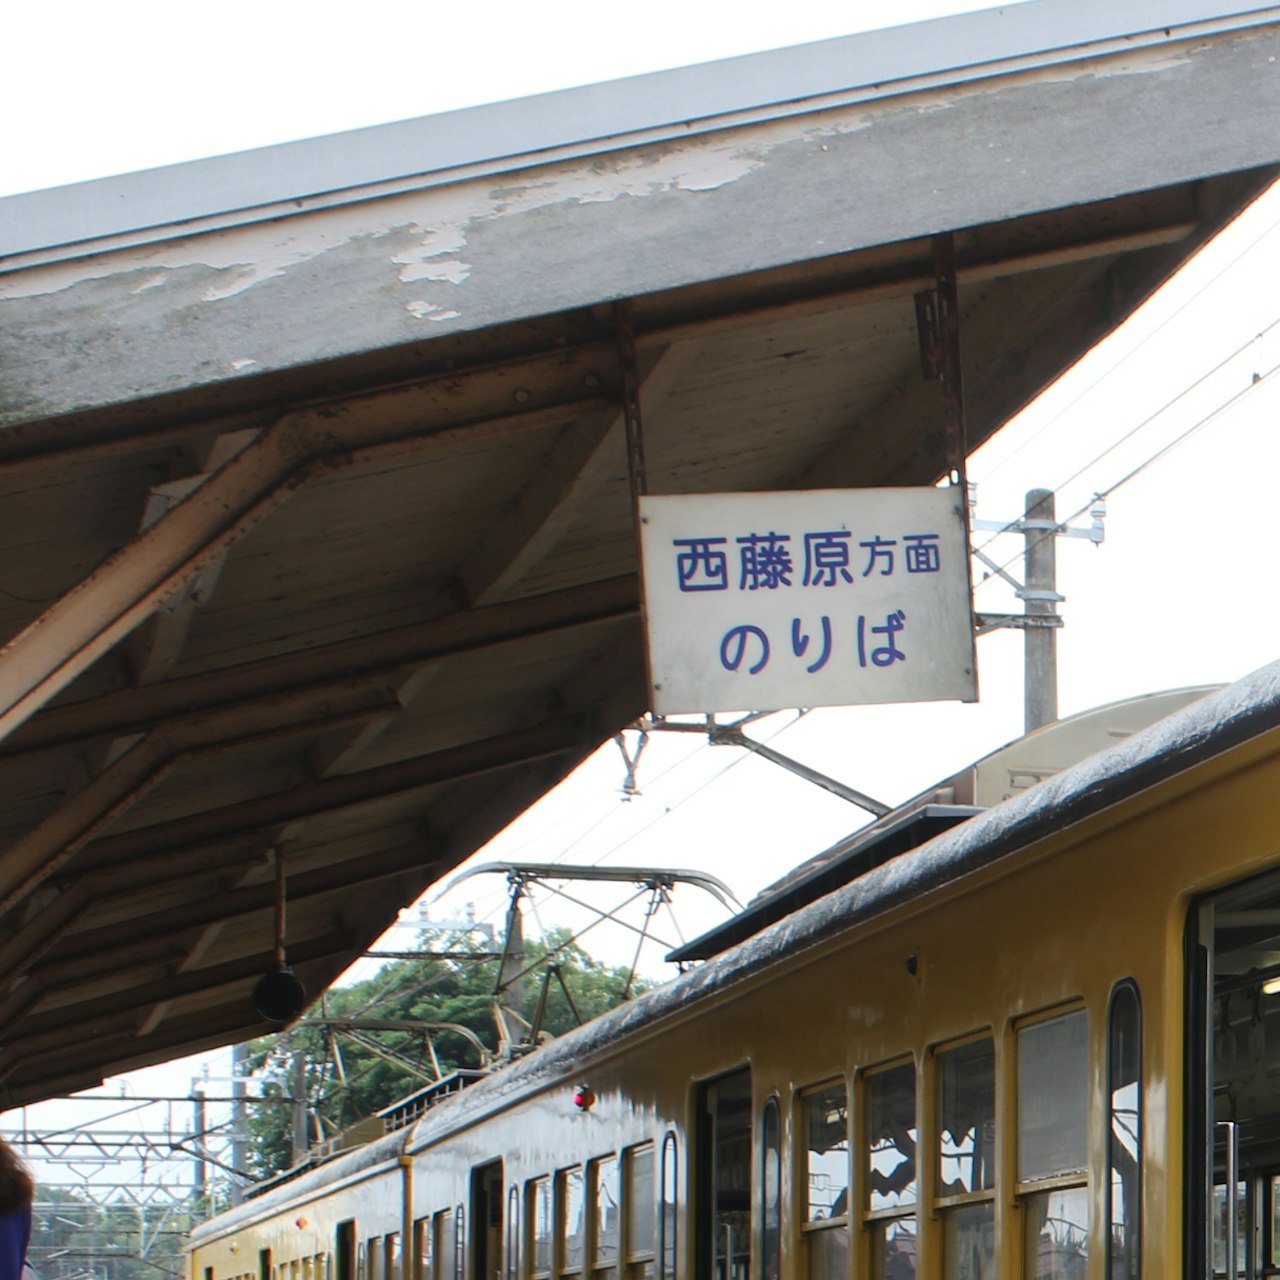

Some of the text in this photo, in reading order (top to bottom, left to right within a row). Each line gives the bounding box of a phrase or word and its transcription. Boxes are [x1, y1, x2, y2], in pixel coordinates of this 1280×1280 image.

[673, 530, 941, 592] 西藤原方面
[720, 608, 906, 675] のりば
